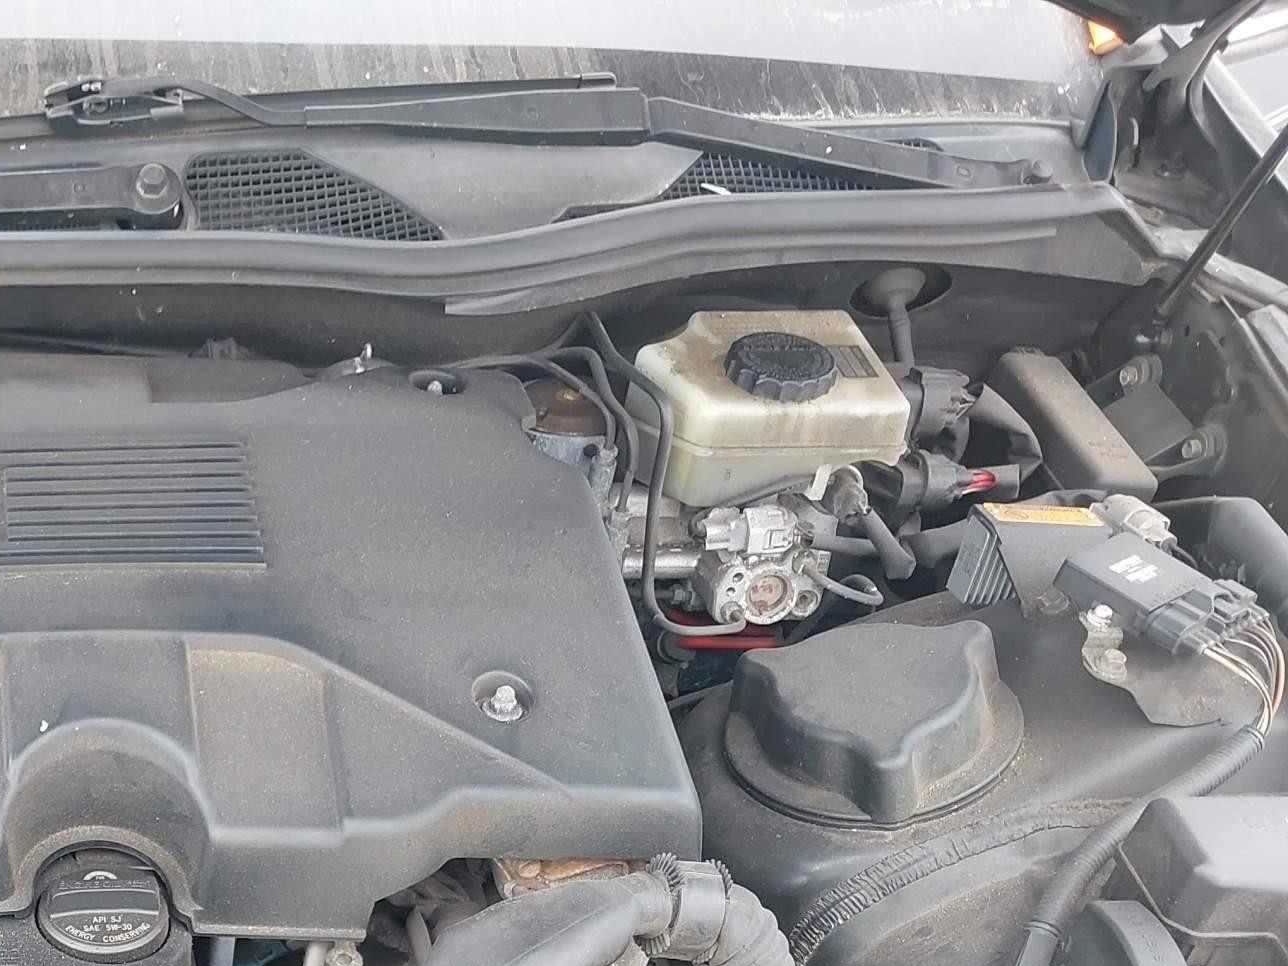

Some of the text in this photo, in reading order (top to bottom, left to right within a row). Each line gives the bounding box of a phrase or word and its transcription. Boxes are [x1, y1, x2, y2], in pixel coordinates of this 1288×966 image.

[111, 915, 122, 923] SJ
[65, 921, 151, 943] ENERGY CONSERVING
[83, 923, 133, 932] SAE 5W-30
